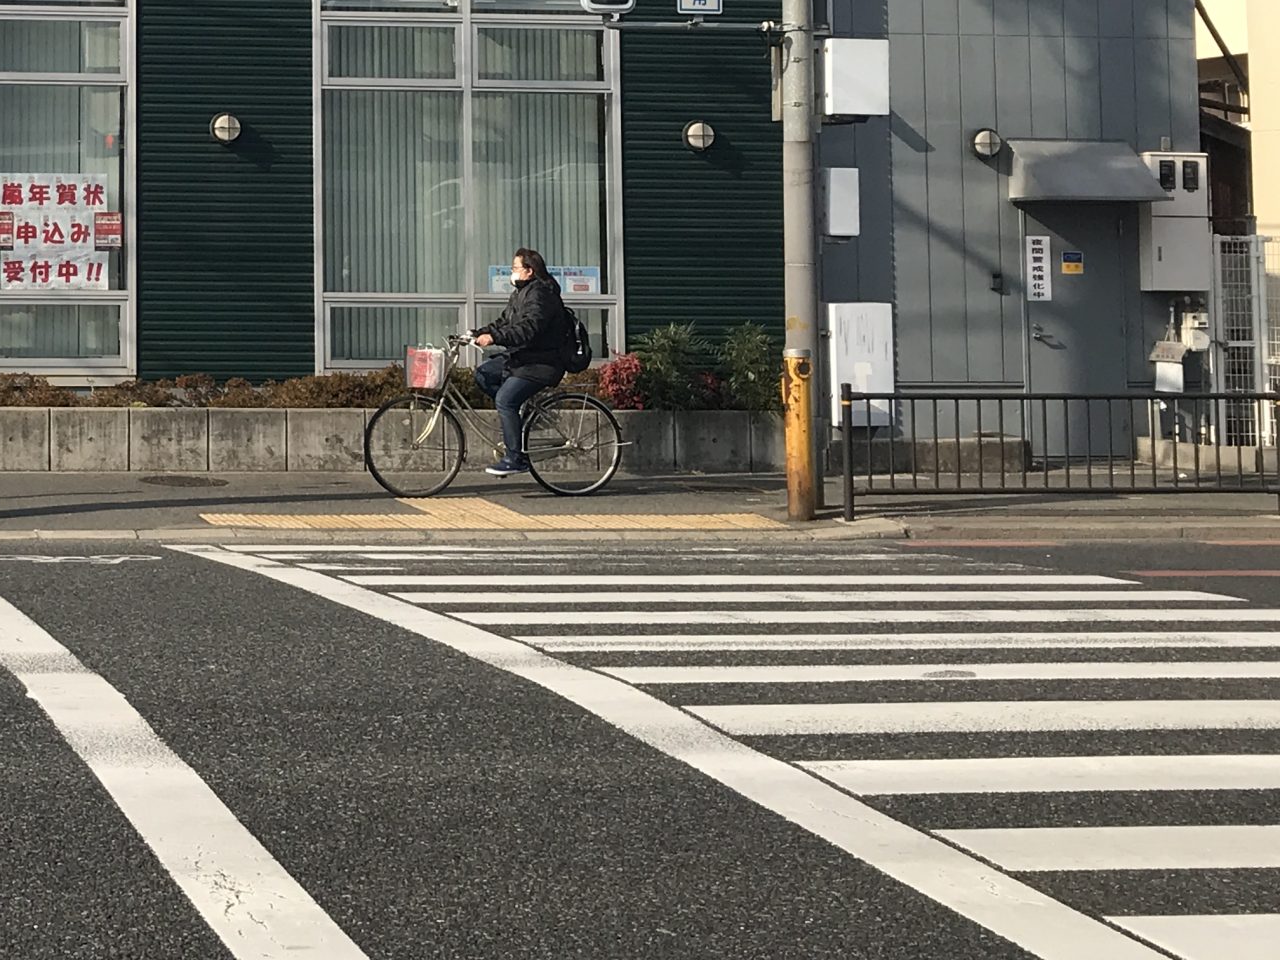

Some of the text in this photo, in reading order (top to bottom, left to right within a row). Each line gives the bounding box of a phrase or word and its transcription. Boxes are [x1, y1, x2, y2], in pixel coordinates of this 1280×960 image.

[1, 183, 104, 206] 嵐年賀状
[16, 221, 91, 245] 申込み
[1031, 238, 1045, 299] 夜間警戒強化中
